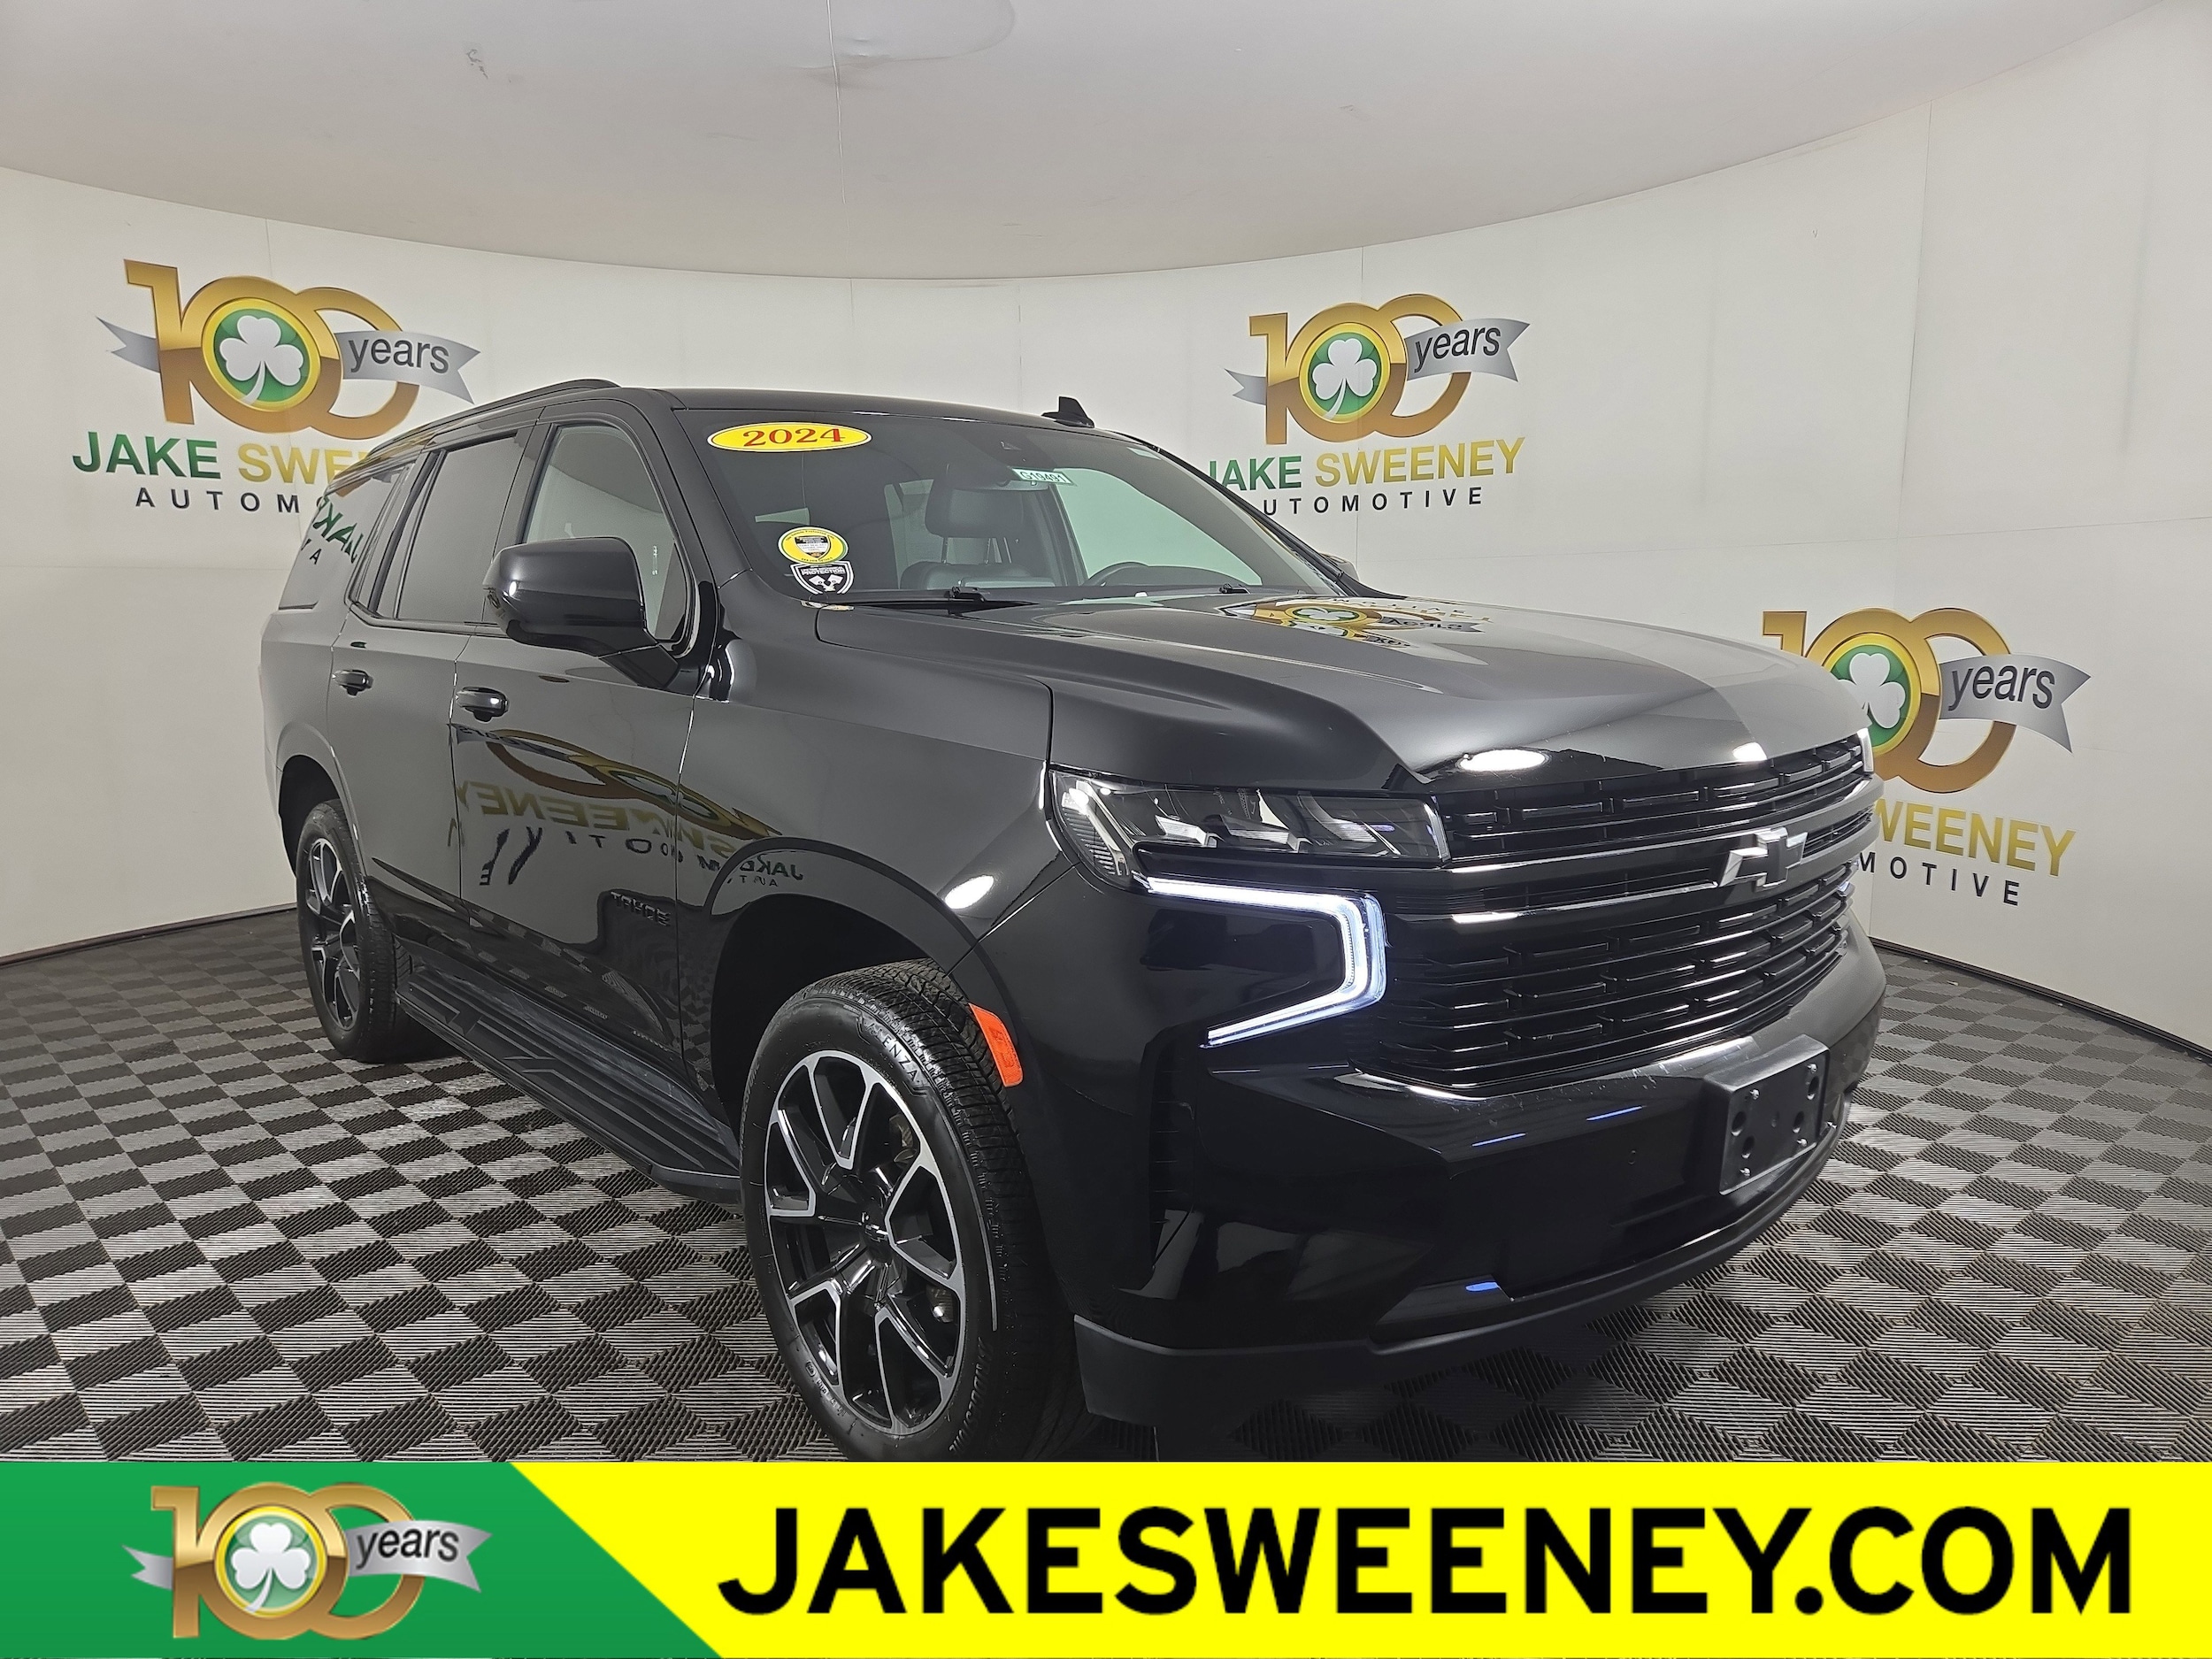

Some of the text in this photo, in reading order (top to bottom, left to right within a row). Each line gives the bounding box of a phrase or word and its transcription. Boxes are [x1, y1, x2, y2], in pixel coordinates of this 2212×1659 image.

[124, 258, 420, 441] 100
[349, 338, 449, 373] years
[1248, 293, 1471, 445] 100
[1414, 324, 1501, 373] years
[73, 431, 221, 480] JAKE
[742, 427, 845, 447] 2024
[1019, 471, 1066, 483] G19491
[1315, 436, 1525, 488] SWEENEY
[135, 487, 326, 514] AUTOM
[1263, 487, 1483, 515] UTOMOTIVE
[1947, 663, 2056, 711] years
[1874, 797, 2078, 877] WEENEY
[1858, 851, 2021, 907] MOTIVE
[611, 891, 672, 926] TAHOE
